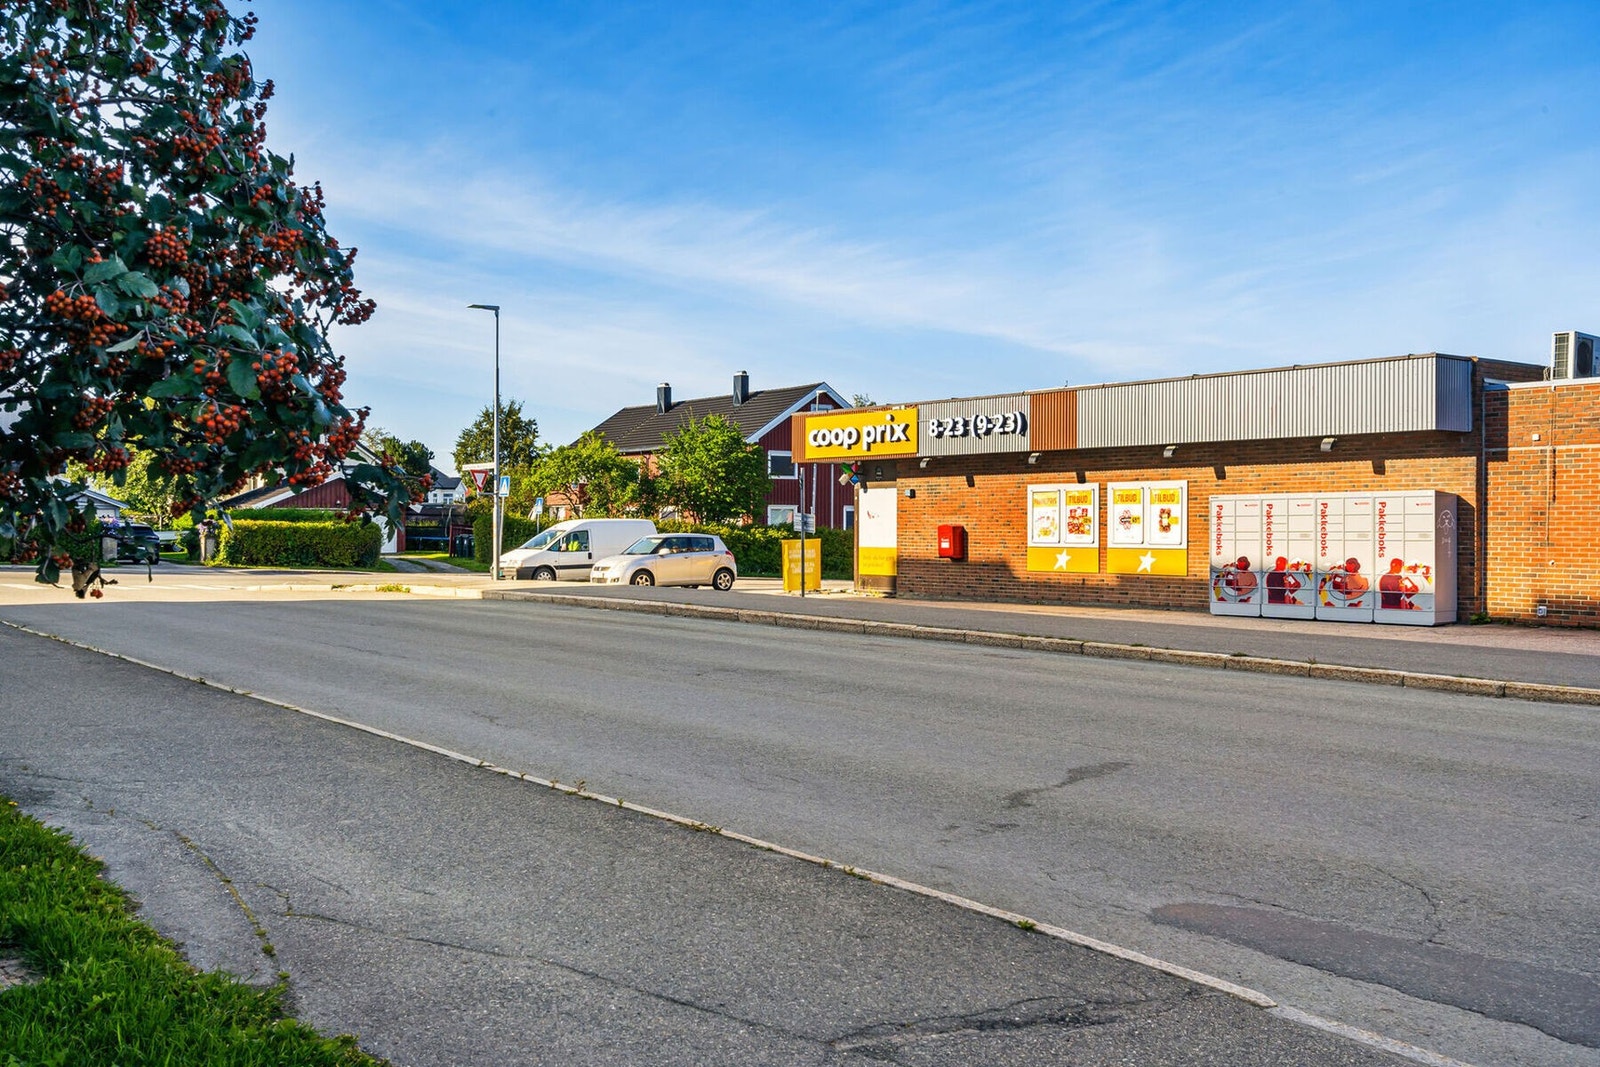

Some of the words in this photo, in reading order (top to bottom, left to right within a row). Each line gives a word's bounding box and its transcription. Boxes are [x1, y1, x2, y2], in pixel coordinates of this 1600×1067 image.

[808, 427, 858, 450] coop
[862, 414, 909, 451] prix
[928, 416, 963, 437] 8-23
[971, 411, 1025, 439] (9-23)
[1068, 495, 1089, 504] TILBUD
[1154, 493, 1176, 503] TILBUD
[1320, 502, 1329, 558] Pakkeboks
[1378, 501, 1387, 559] Pakkeboks
